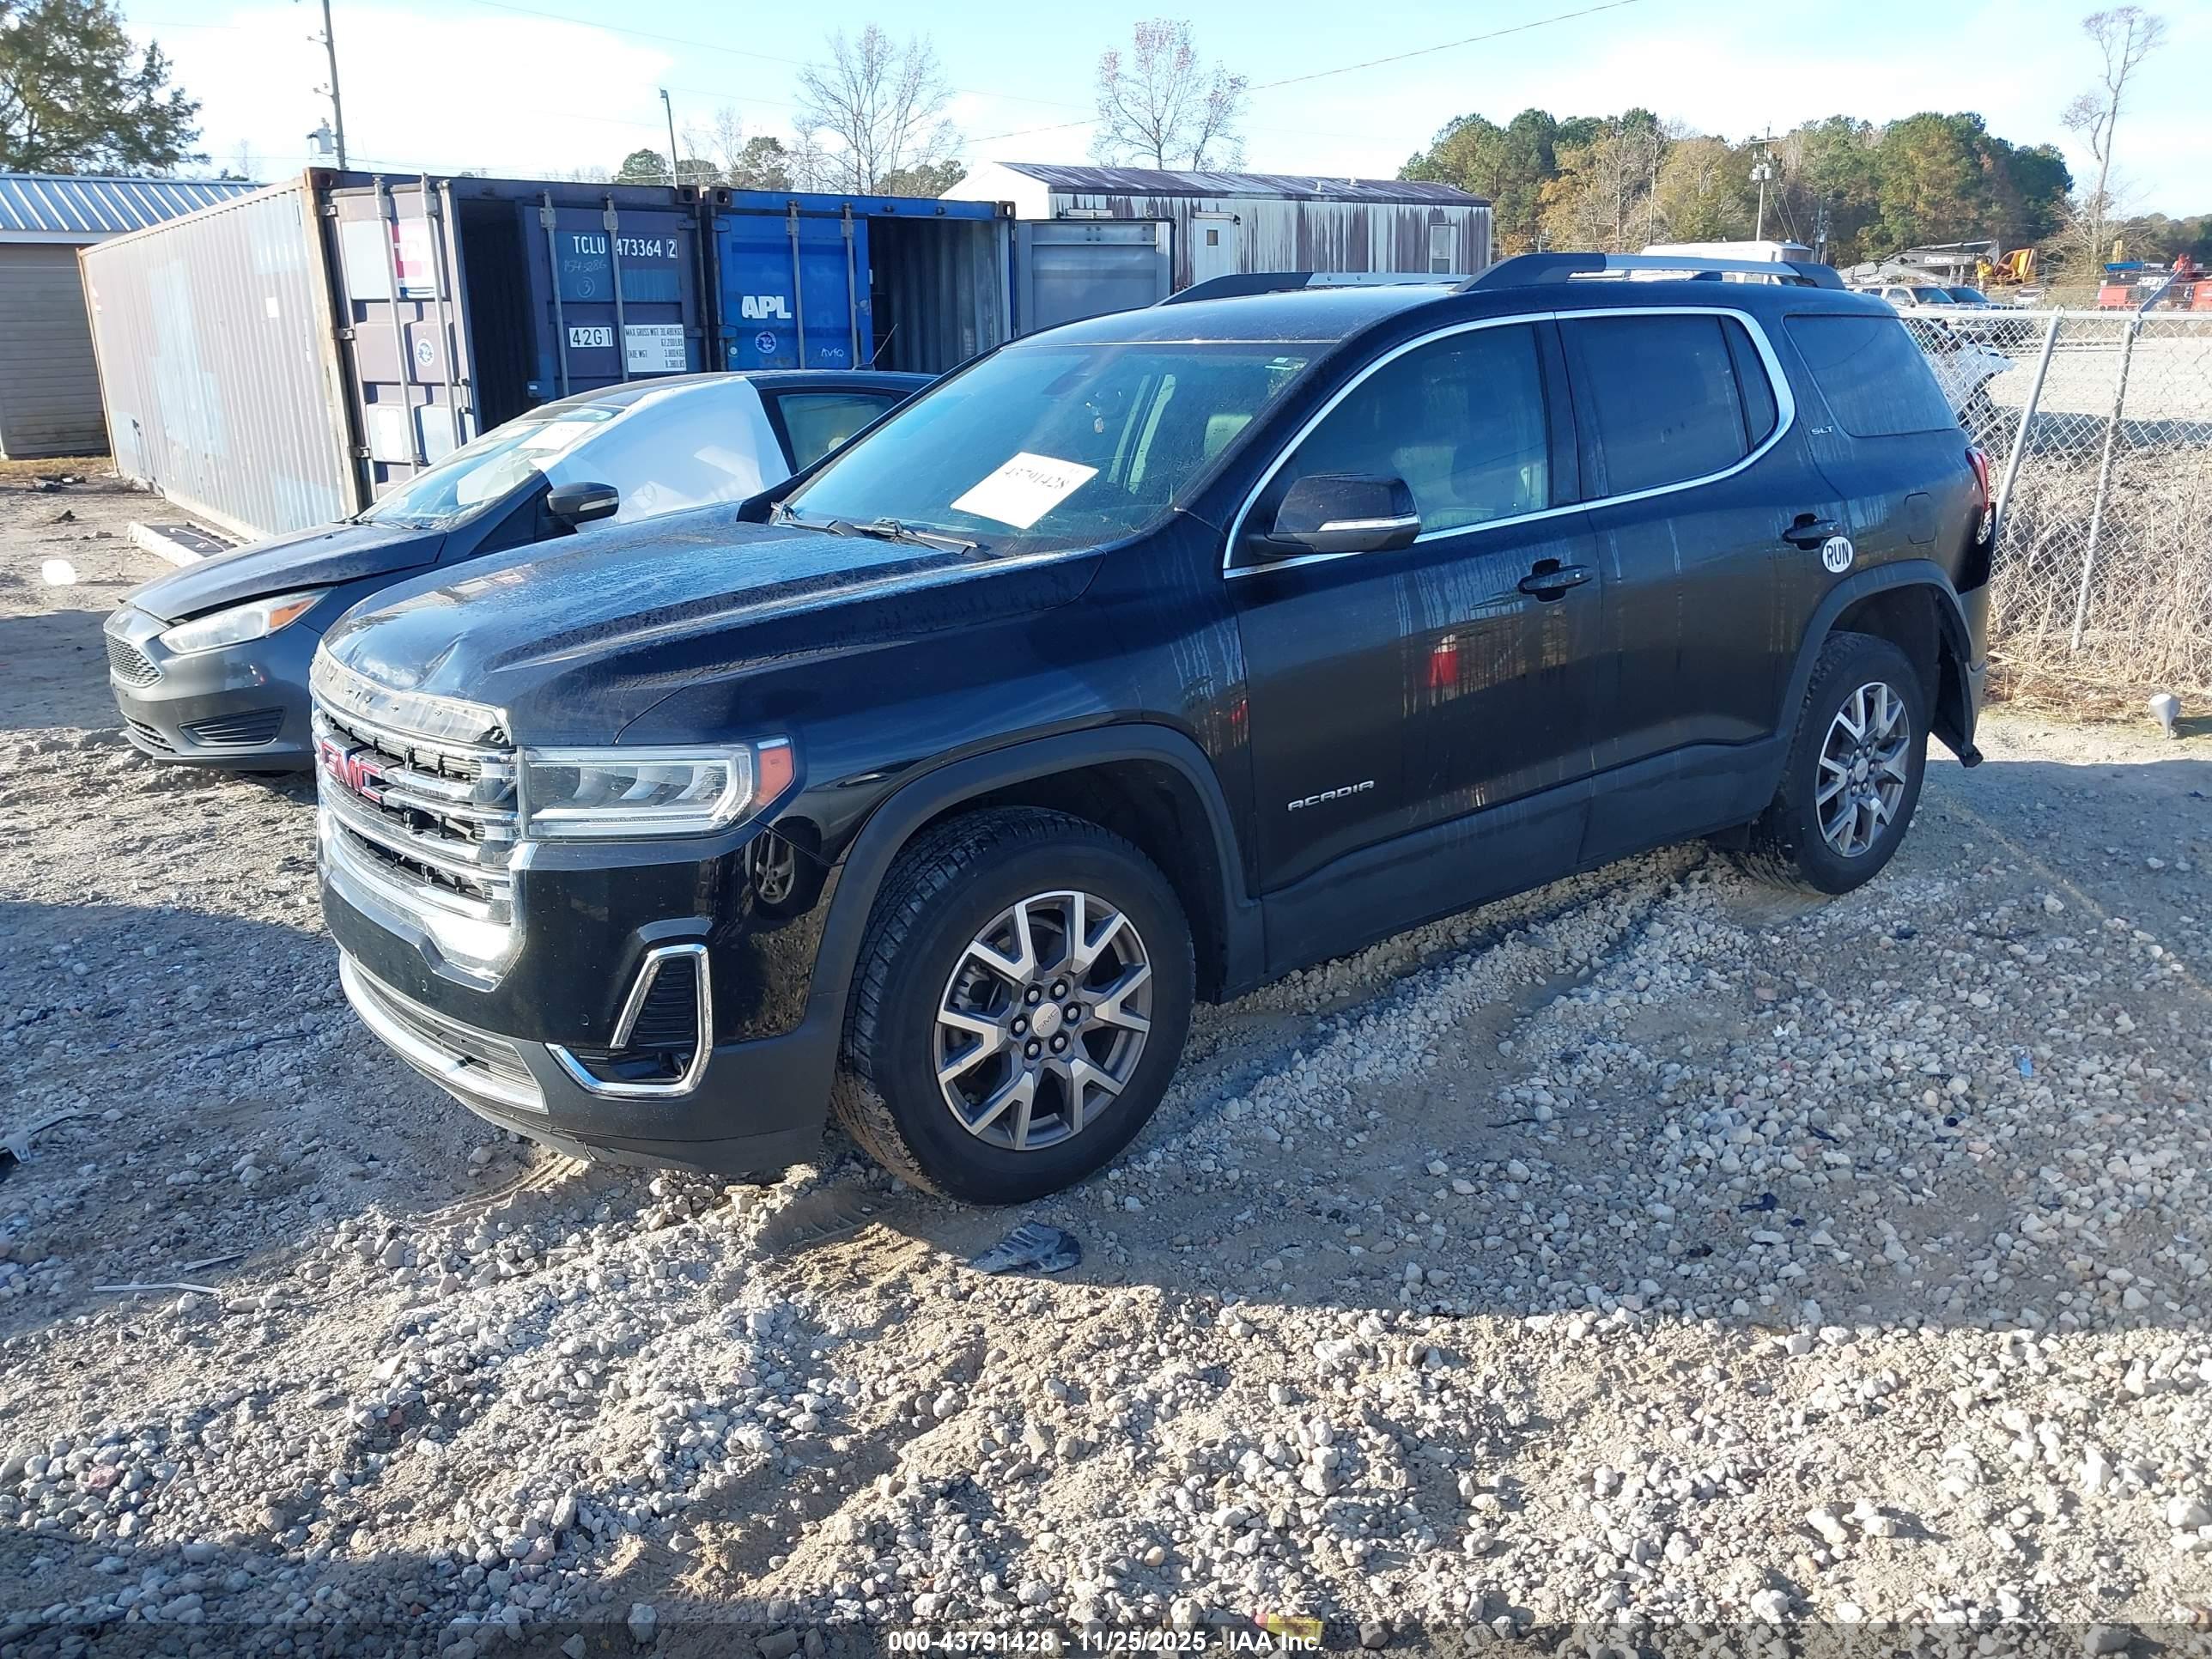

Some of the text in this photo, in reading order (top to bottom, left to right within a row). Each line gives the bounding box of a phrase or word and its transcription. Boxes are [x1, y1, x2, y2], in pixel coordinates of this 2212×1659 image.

[573, 235, 678, 258] TCLU 473364 2
[741, 295, 793, 319] APL
[572, 328, 612, 346] 42G1
[1811, 425, 1834, 435] SLT
[1826, 541, 1850, 568] RUN
[321, 740, 386, 805] GMC
[1287, 780, 1375, 812] ACADIA
[1036, 1007, 1059, 1032] GMC
